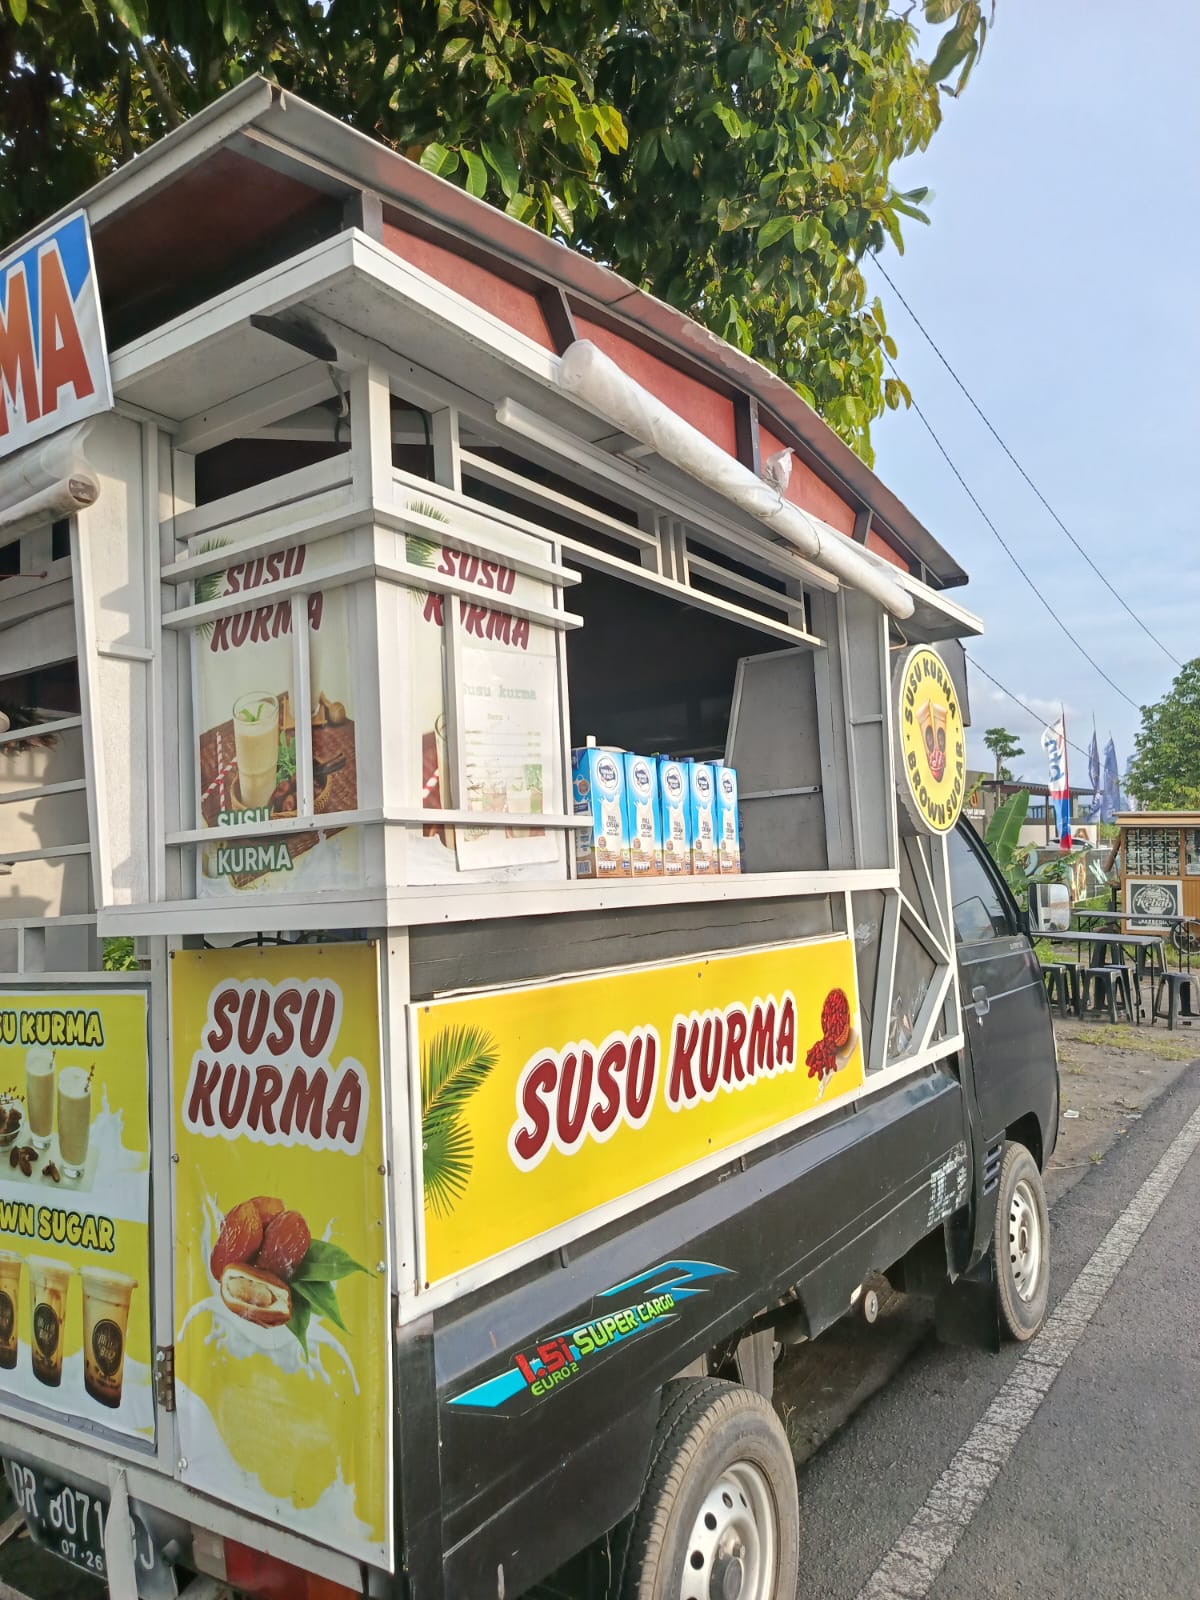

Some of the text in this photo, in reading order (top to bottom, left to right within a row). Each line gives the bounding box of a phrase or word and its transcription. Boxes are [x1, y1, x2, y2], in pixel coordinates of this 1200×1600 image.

[223, 544, 306, 596] SUSU
[437, 546, 516, 595] SUSU
[210, 591, 324, 652] KURMA
[905, 657, 956, 725] SUSU KURMA
[907, 750, 946, 824] BROWN
[945, 741, 963, 820] SUGAR
[218, 844, 293, 873] KURMA
[0, 1010, 104, 1047] U KURMA
[207, 988, 336, 1058] SUSU
[188, 1059, 362, 1144] KURMA
[514, 997, 794, 1160] SUSU KURMA
[38, 1206, 115, 1252] SUGAR
[572, 1309, 638, 1356] SUPER
[637, 1293, 675, 1323] CARGO
[11, 1461, 38, 1517] DR
[50, 1487, 105, 1549] 8071
